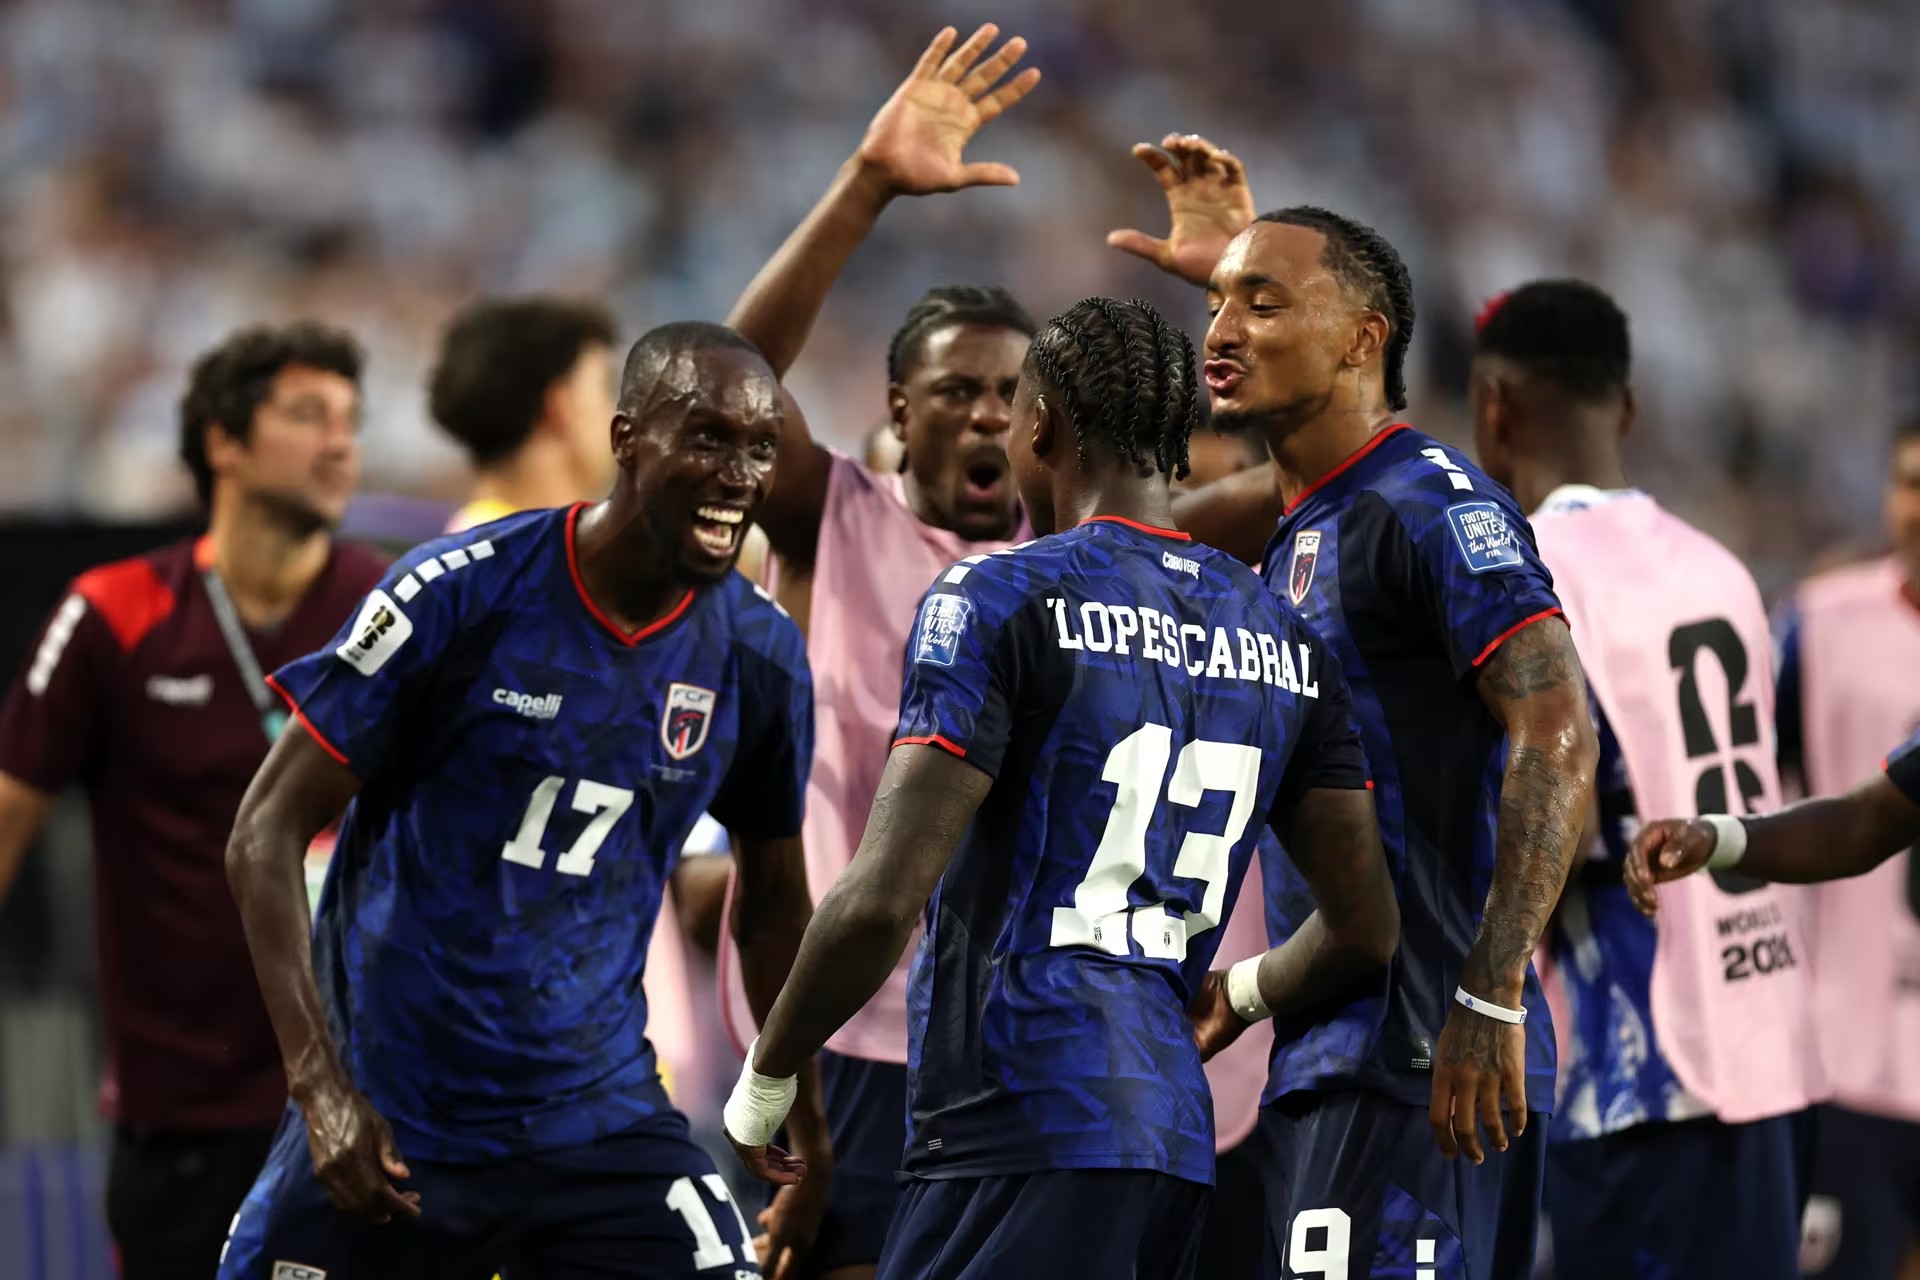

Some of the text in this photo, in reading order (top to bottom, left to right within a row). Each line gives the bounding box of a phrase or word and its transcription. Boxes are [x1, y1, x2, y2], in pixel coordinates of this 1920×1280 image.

[492, 688, 563, 714] capelli
[501, 775, 635, 877] 17
[1049, 722, 1262, 964] 13
